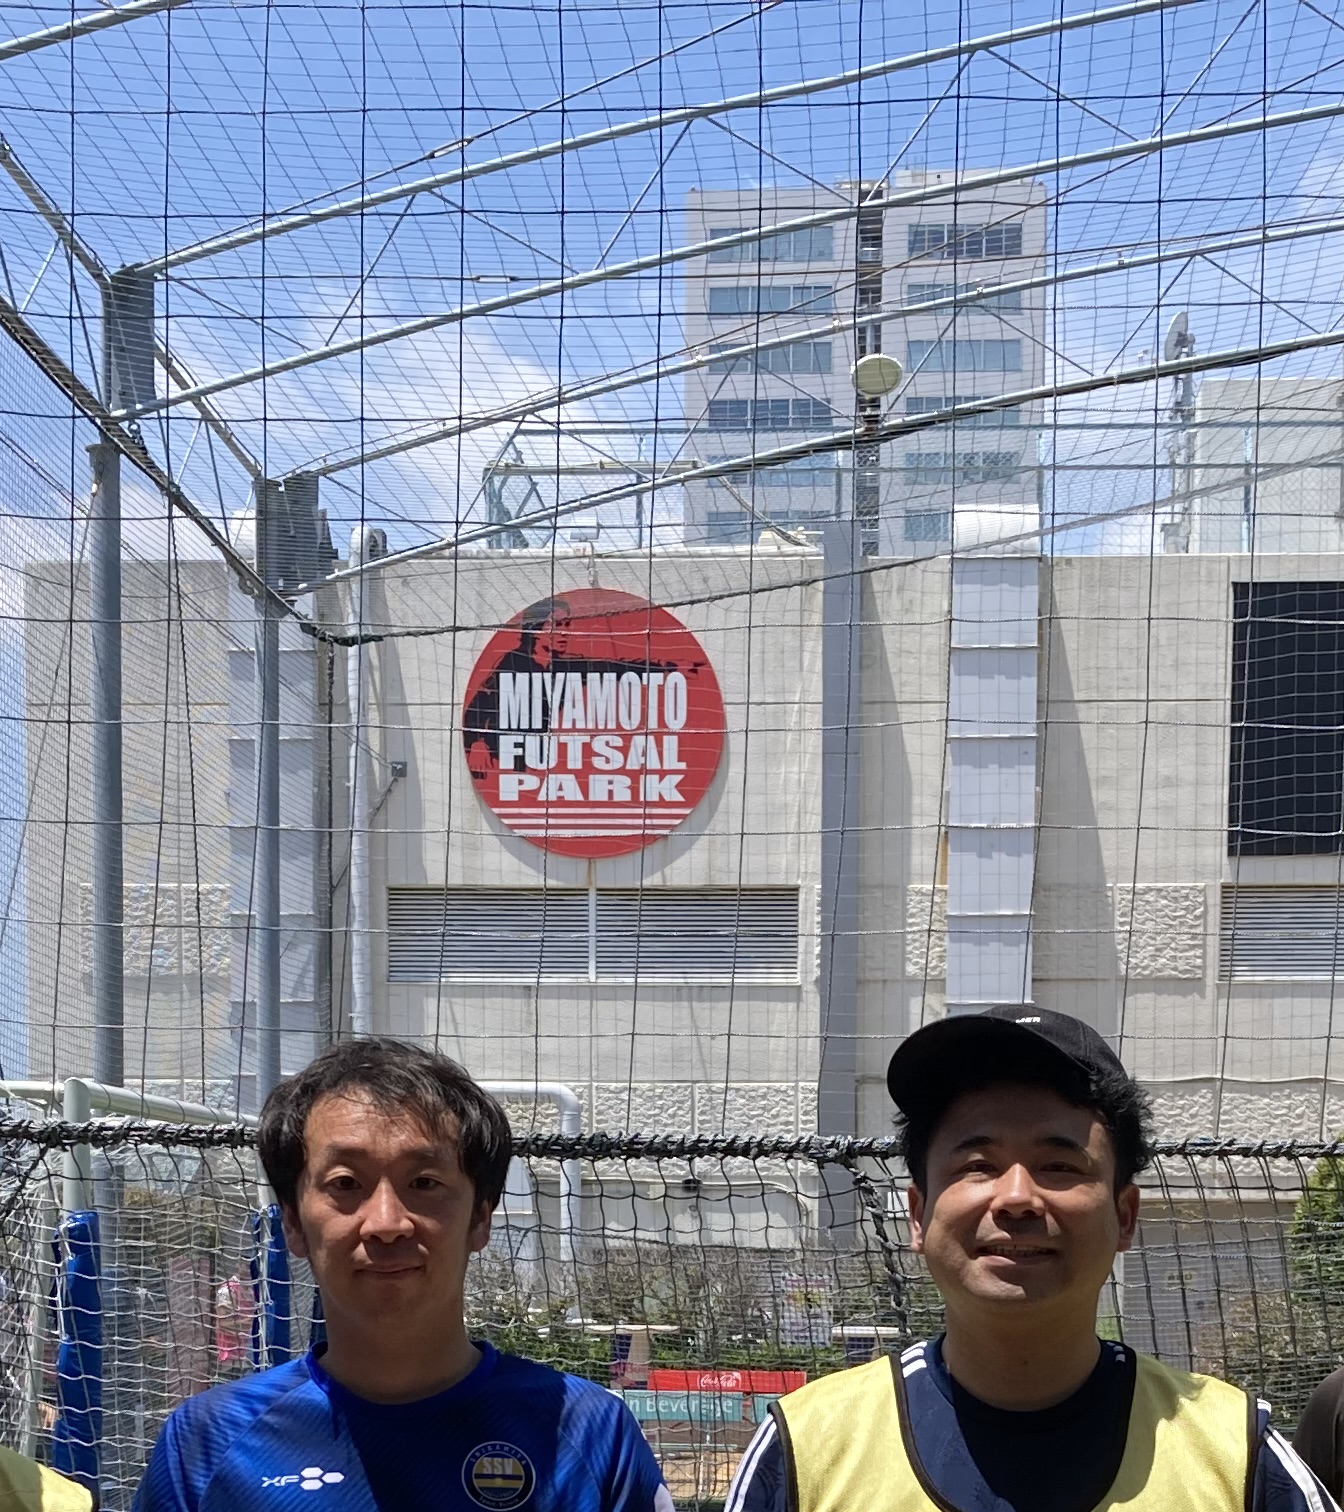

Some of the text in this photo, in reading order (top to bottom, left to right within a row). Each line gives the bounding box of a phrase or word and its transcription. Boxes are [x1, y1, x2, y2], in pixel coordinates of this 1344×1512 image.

[498, 671, 688, 730] MIYAMOTO
[498, 735, 687, 771] FUTSAL
[498, 774, 686, 802] PARK
